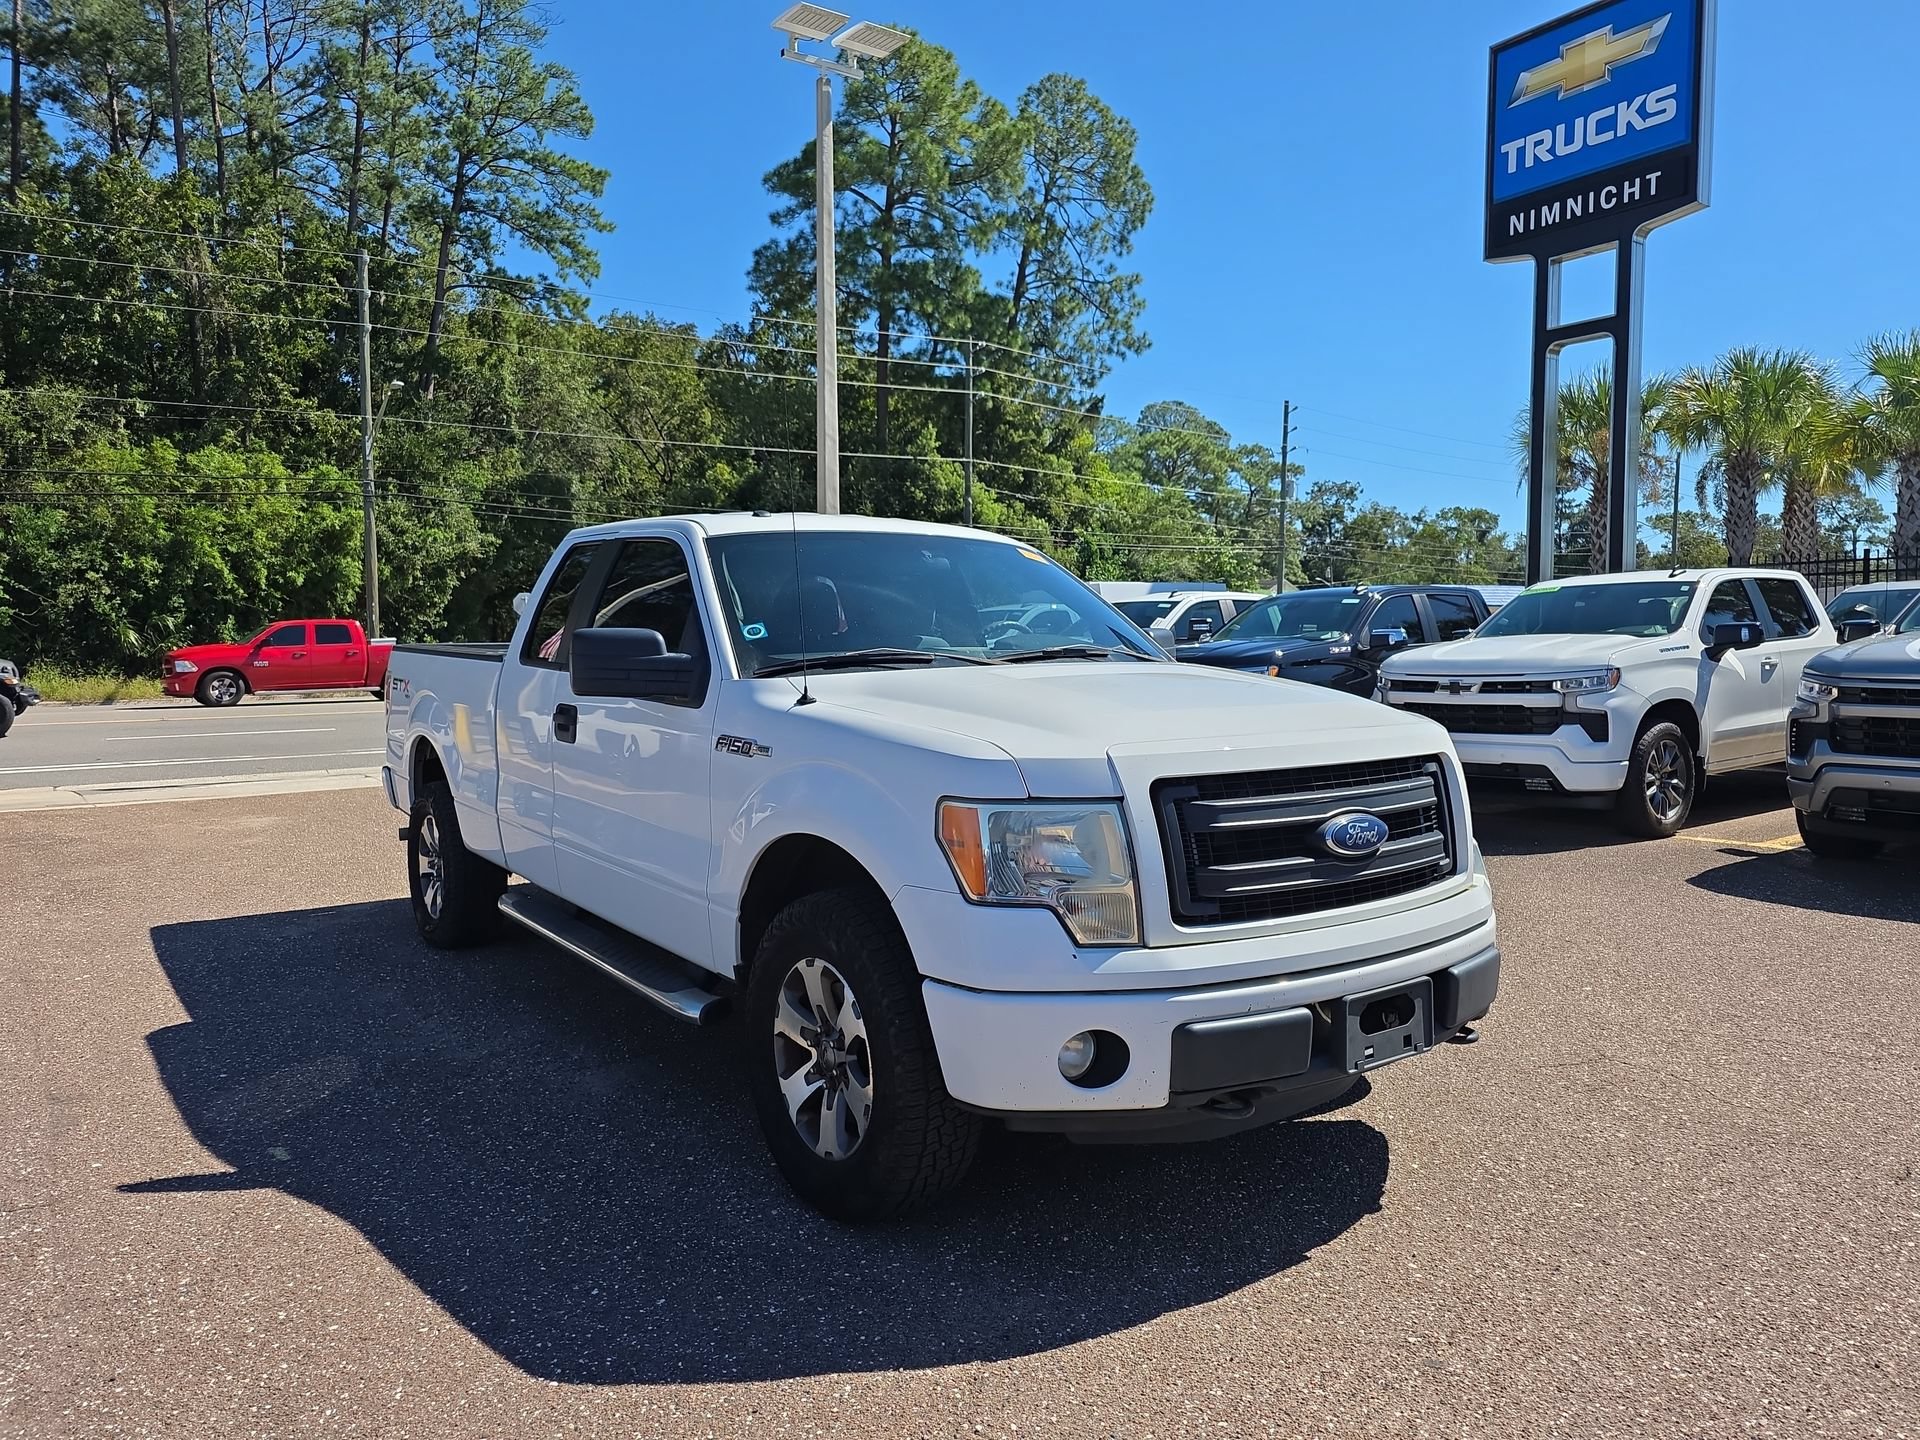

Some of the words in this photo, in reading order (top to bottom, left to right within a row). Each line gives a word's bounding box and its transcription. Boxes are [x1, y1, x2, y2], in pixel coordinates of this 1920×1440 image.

[1501, 84, 1677, 173] TRUCKS
[1509, 171, 1662, 236] NIMNICHT
[1346, 822, 1379, 846] Ford
